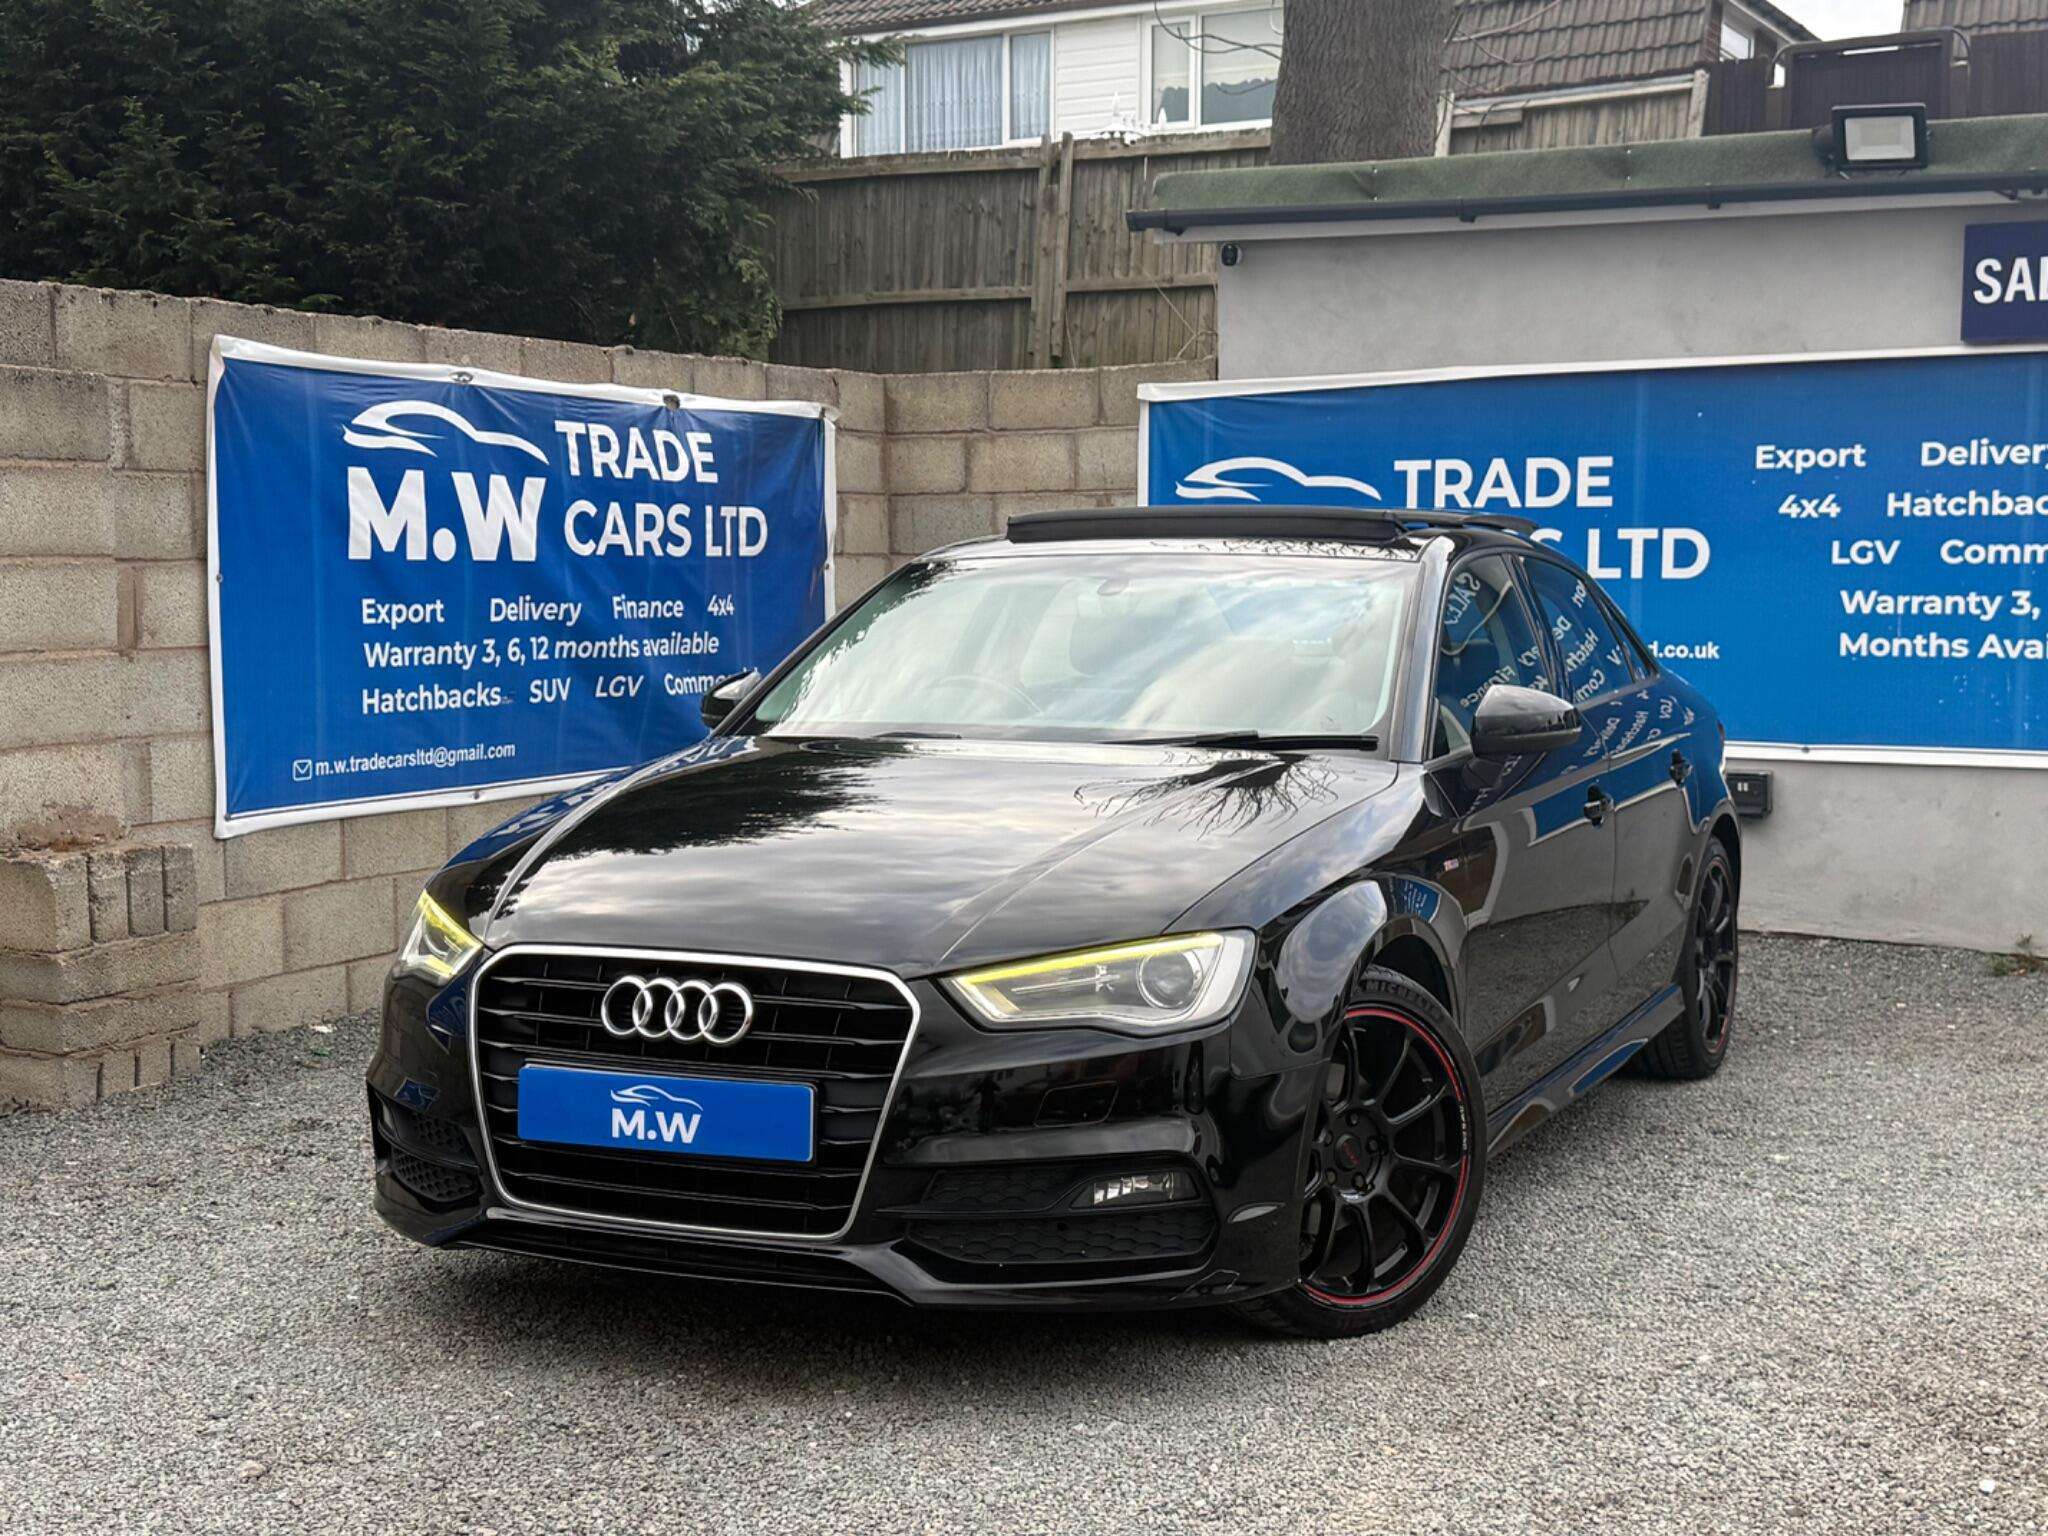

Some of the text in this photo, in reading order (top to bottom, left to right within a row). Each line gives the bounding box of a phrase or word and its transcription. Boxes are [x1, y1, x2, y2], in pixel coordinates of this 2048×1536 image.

[554, 420, 719, 484] TRADE
[1755, 438, 2048, 475] Export Deliver
[1393, 455, 1614, 509] TRADE
[347, 466, 547, 562] M.W
[1778, 494, 1841, 519] 4x4
[563, 499, 768, 558] CARS LTD
[1587, 528, 1711, 579] LTD
[1831, 539, 1901, 565] LGV
[361, 593, 735, 630] Export Delivery Finance 4x4
[1840, 590, 2041, 621] Warranty 3,
[364, 631, 720, 670] Warranty 3, 6, 12 months available
[1839, 632, 1969, 658] Months
[362, 682, 502, 715] Hatchbacks
[528, 676, 572, 704] SUV
[595, 675, 645, 698] LGV
[315, 743, 516, 776] m.w.tradecarsltd@gmail.com
[611, 1107, 702, 1144] M.W
